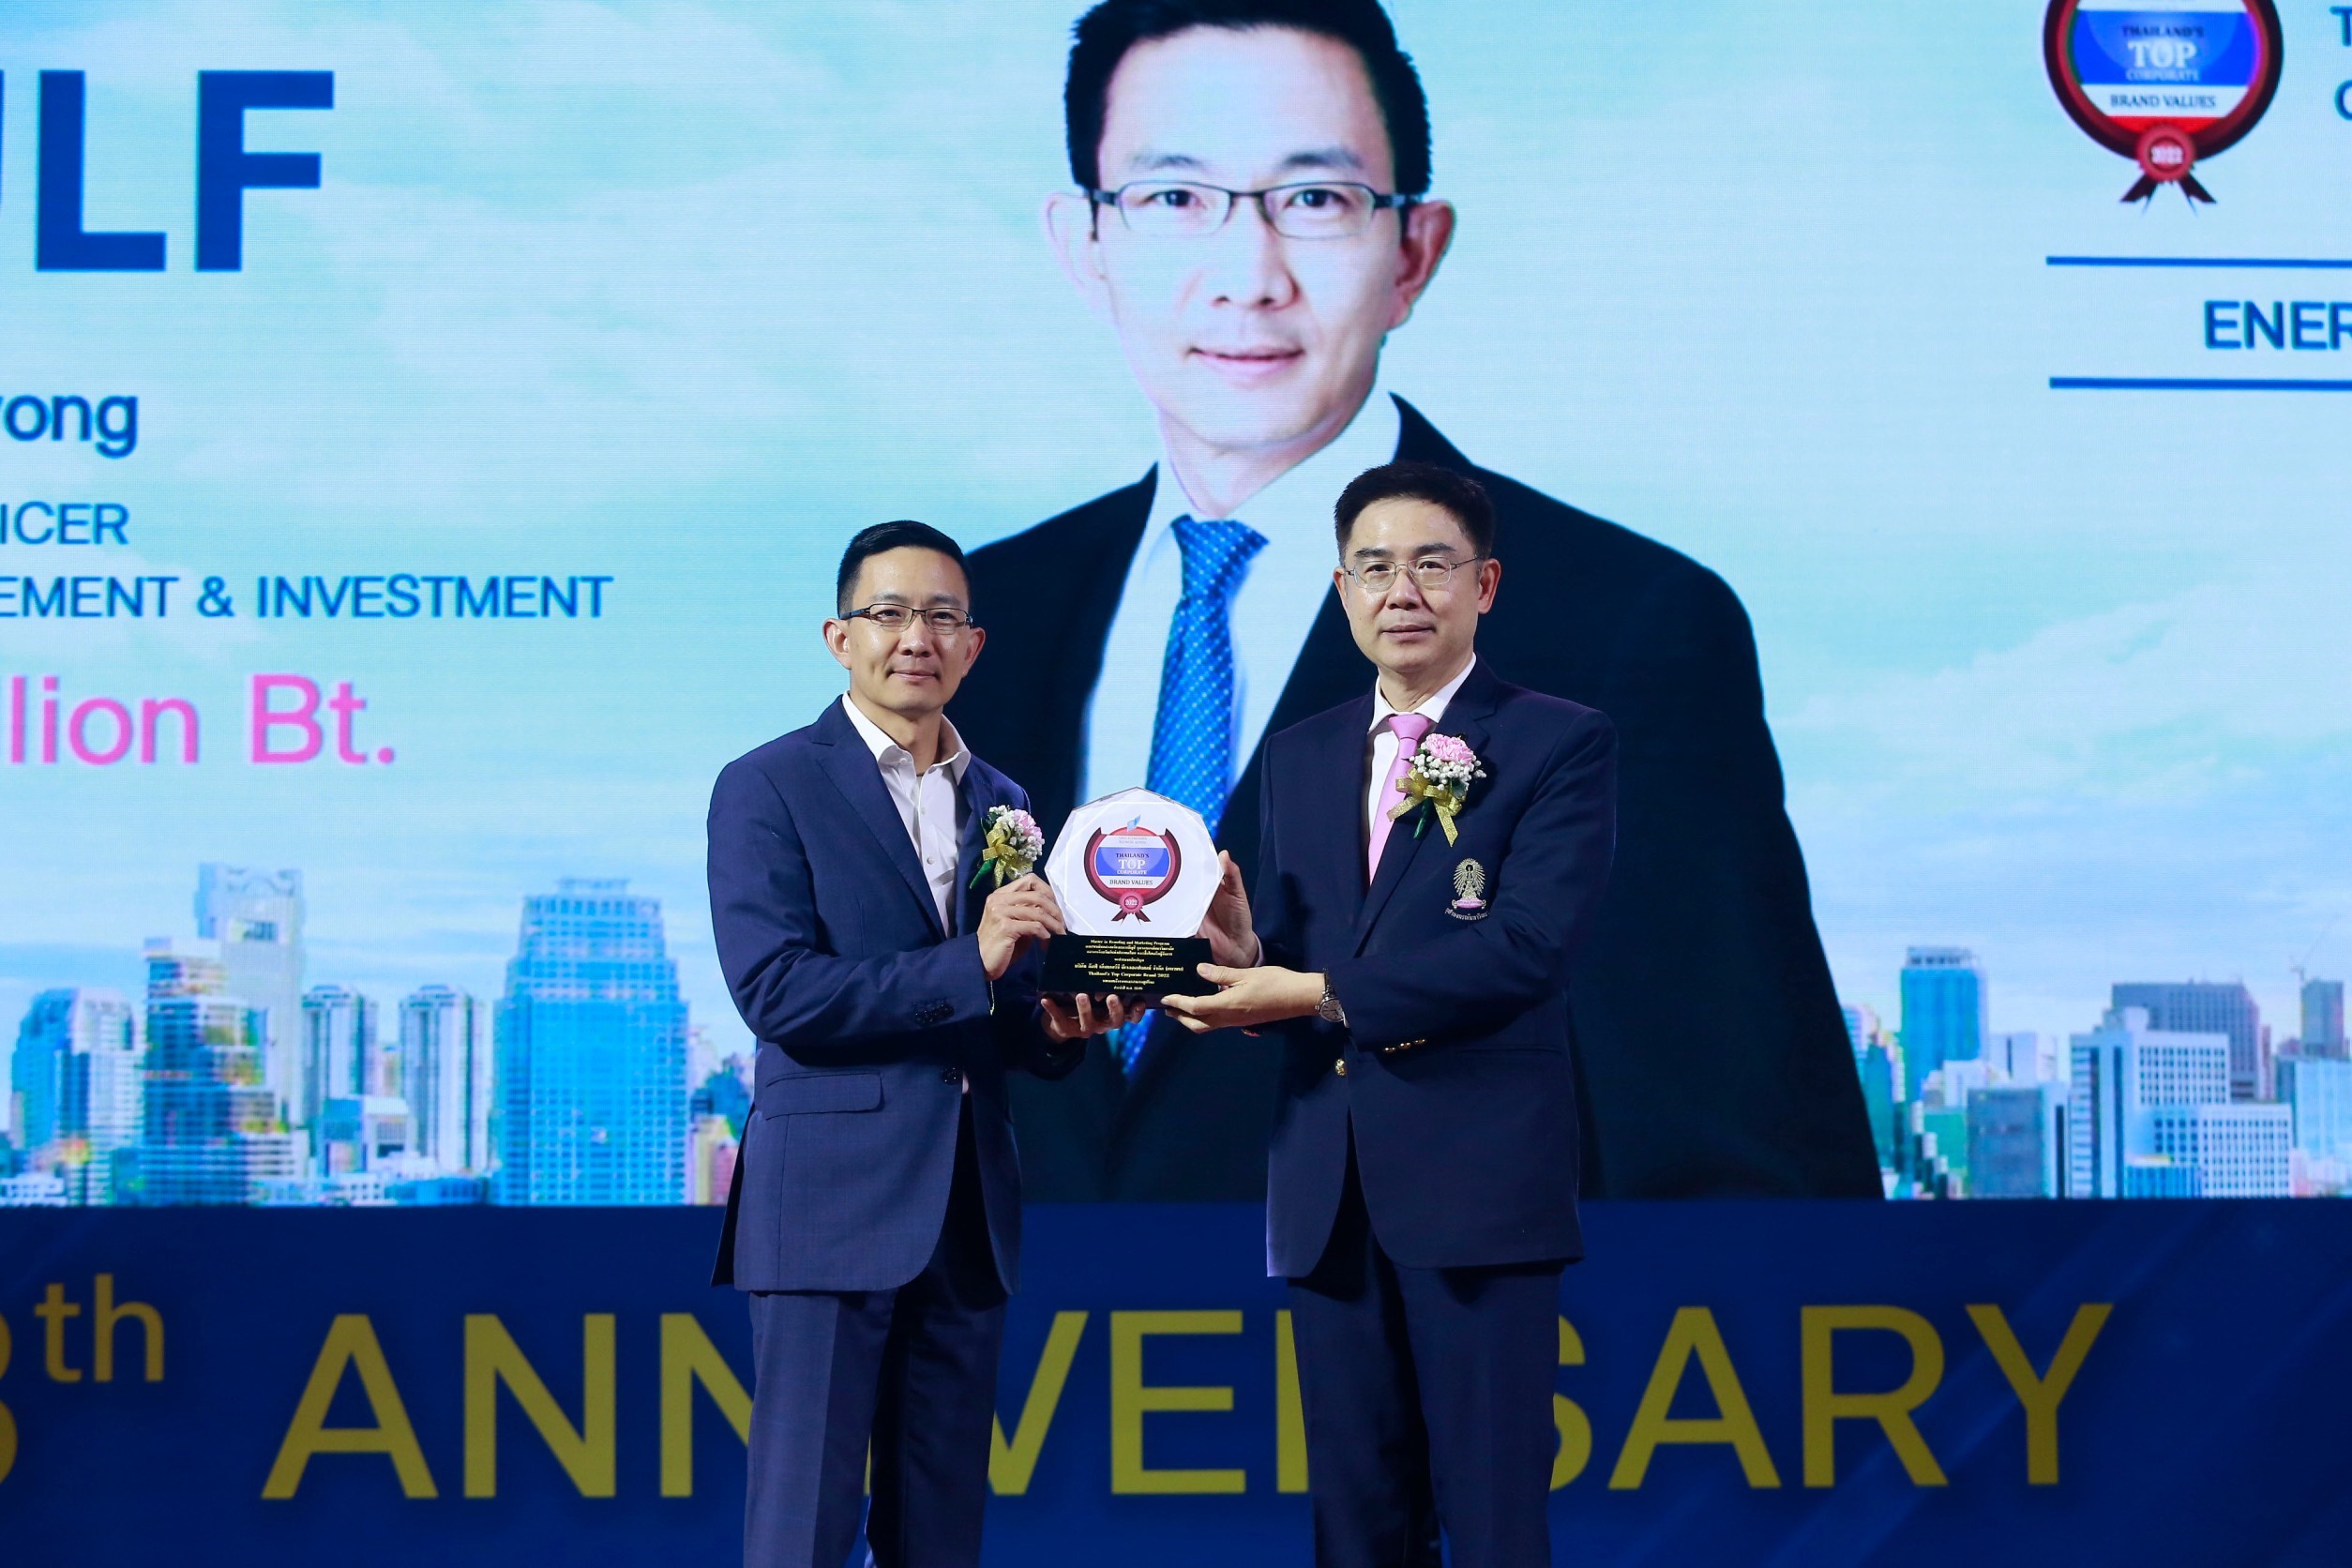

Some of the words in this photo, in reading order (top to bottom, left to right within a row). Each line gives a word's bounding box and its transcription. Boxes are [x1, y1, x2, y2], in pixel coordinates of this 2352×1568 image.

[2127, 38, 2197, 68] TOP
[2110, 95, 2160, 107] BRAND
[2162, 95, 2216, 108] VALUES
[0, 69, 335, 273] LF
[0, 395, 138, 460] ong
[196, 575, 235, 619] &
[257, 573, 615, 619] INVESTMENT
[11, 675, 200, 766] lion
[250, 673, 396, 765] Bt.
[1118, 859, 1146, 869] TOP
